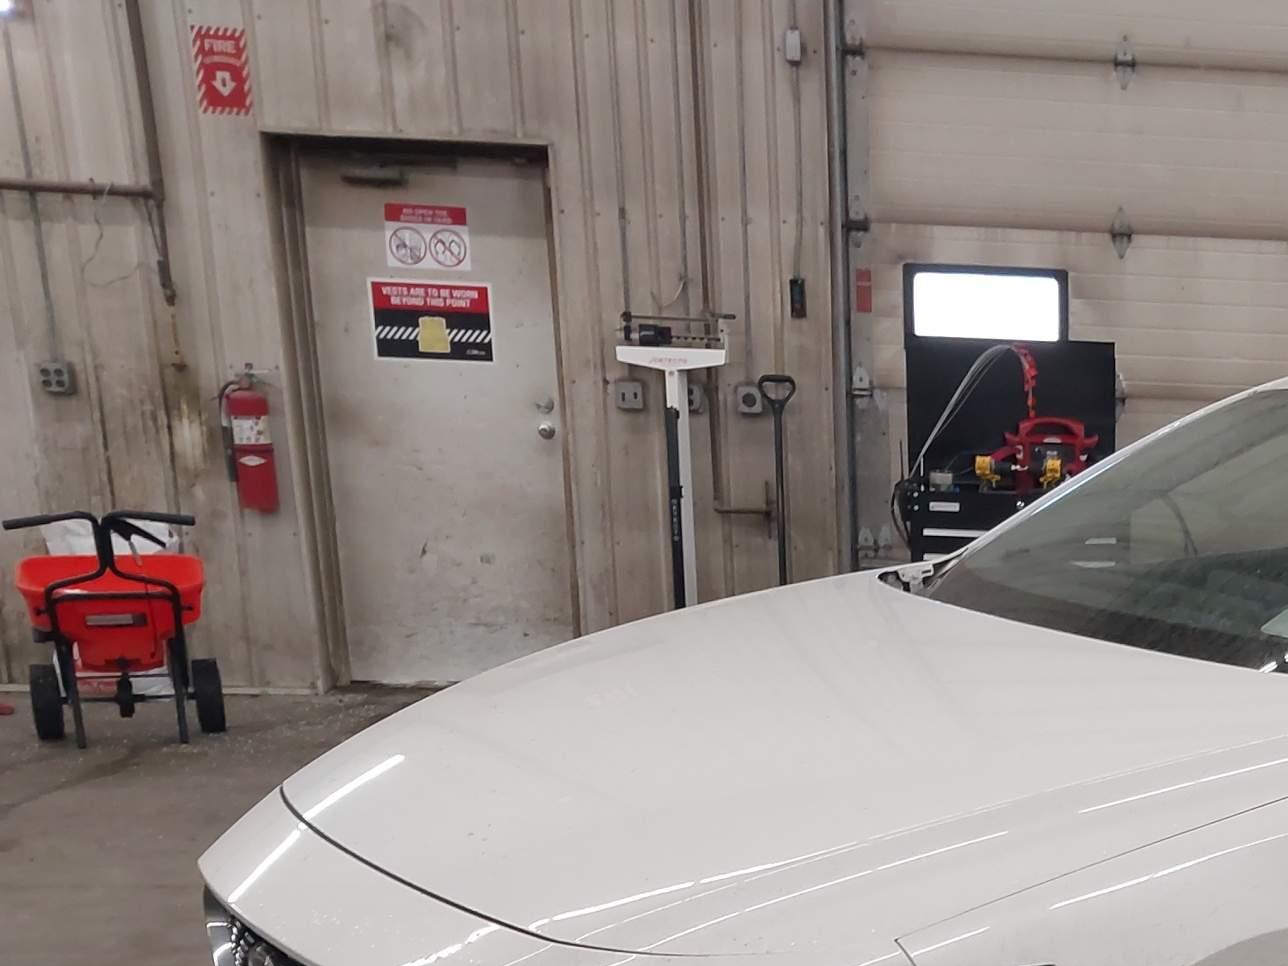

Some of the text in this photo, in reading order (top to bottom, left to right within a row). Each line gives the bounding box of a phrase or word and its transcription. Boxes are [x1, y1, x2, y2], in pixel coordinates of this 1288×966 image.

[204, 38, 237, 53] FIRE
[380, 286, 479, 299] VESTS ARE TO BE WORN
[390, 296, 471, 307] BEYOND THIS POINT
